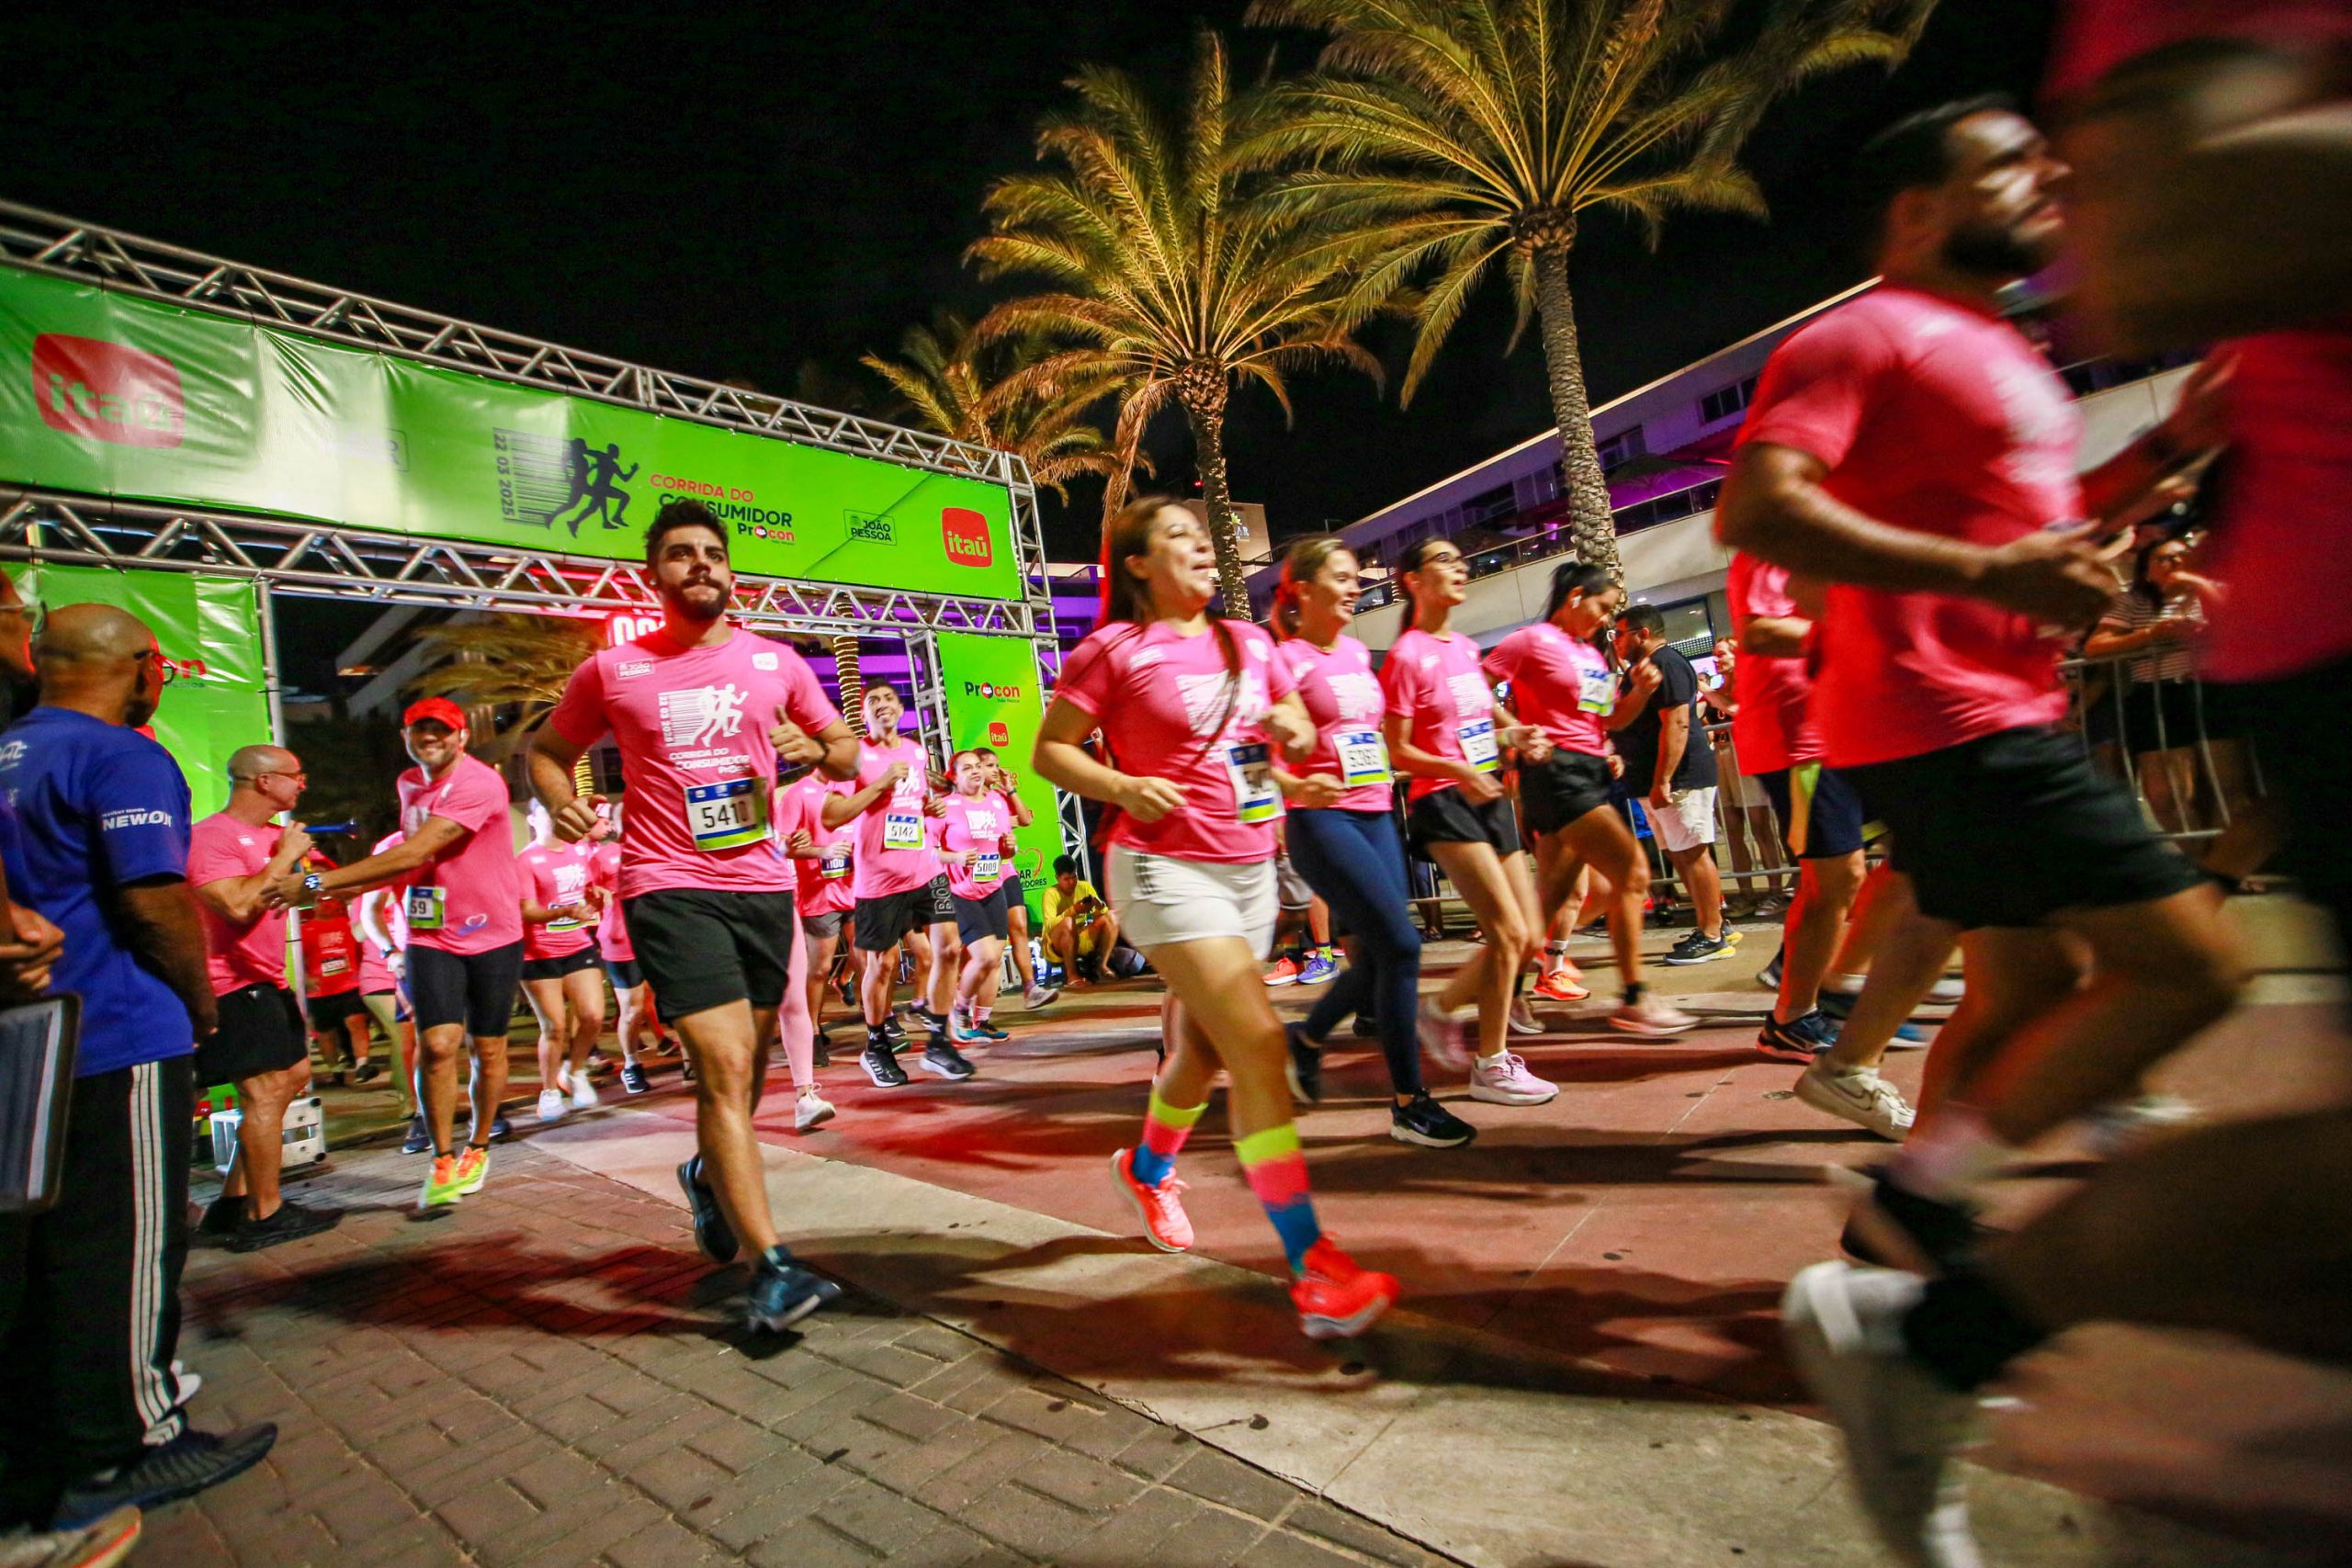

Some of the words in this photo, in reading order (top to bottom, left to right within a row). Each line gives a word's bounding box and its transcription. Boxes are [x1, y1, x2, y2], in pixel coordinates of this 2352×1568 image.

[493, 433, 508, 452] 22
[496, 456, 511, 475] 03
[650, 473, 725, 499] CORRIDA
[729, 487, 754, 502] DO
[499, 479, 516, 516] 2025
[659, 493, 793, 527] CSUMIDOR
[851, 527, 892, 542] PESSOA
[863, 518, 891, 533] JOÃO
[947, 530, 989, 558] itaú
[964, 681, 1021, 699] Procon
